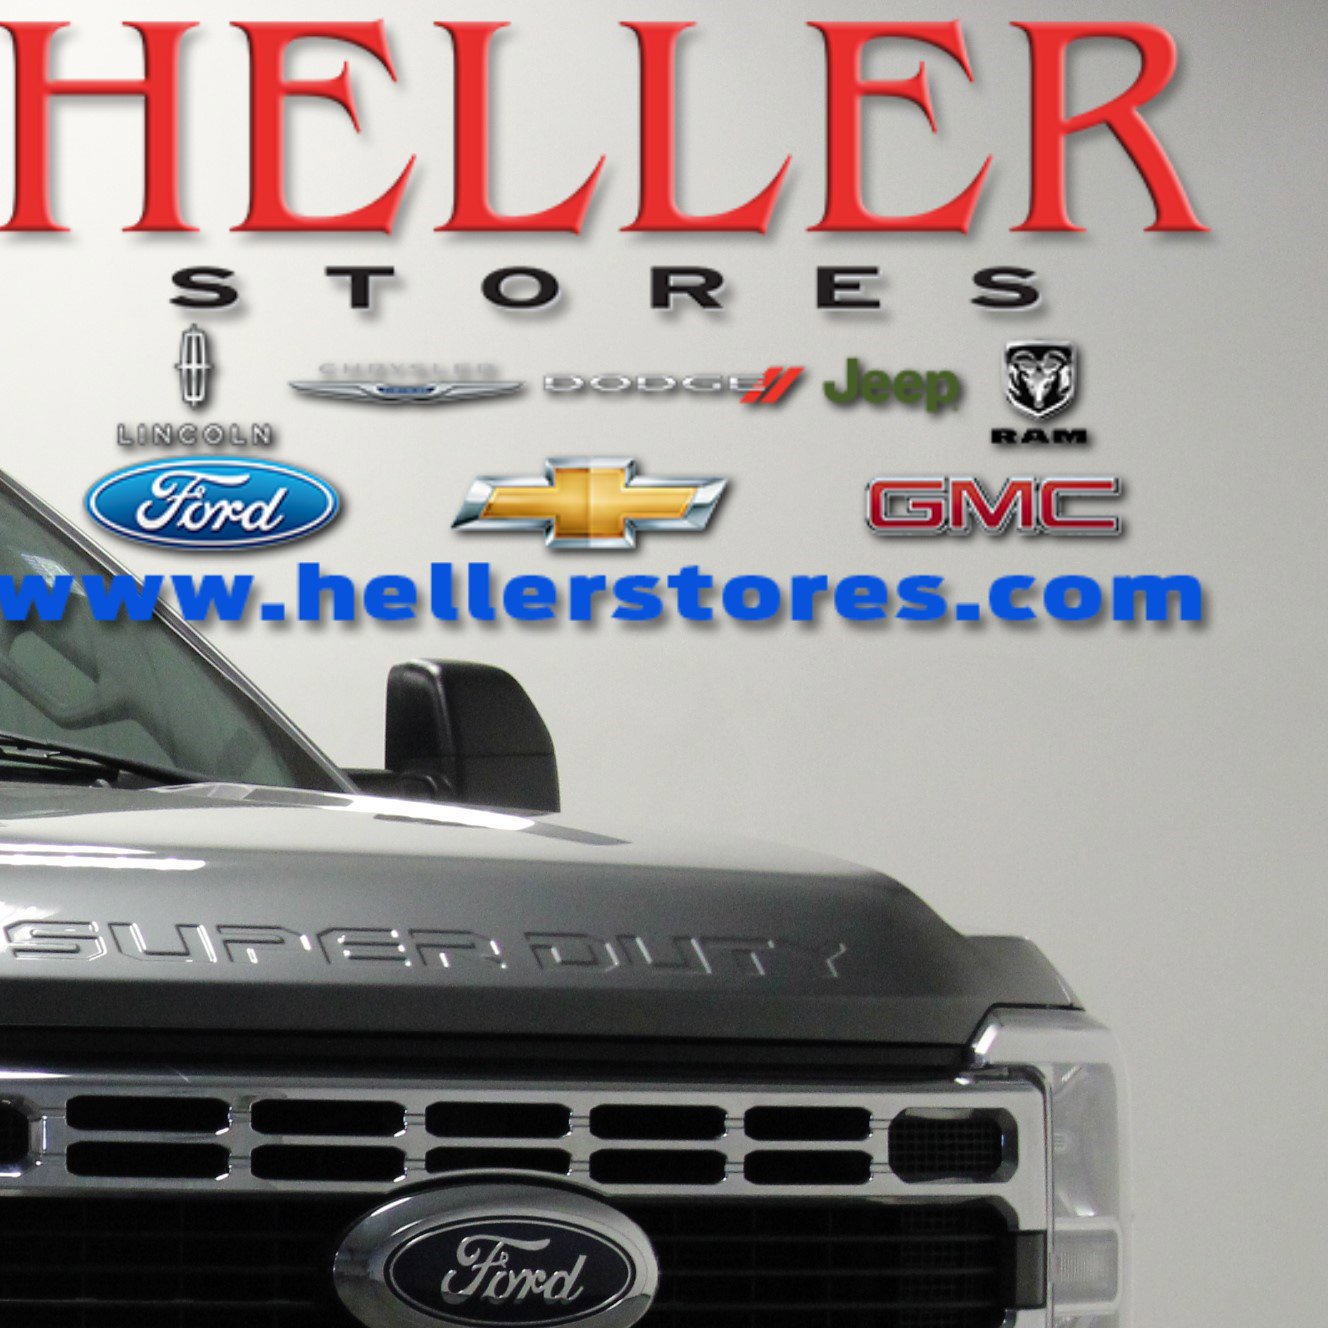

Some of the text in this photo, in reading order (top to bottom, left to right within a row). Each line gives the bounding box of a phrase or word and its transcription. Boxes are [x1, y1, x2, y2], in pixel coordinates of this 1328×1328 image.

[2, 918, 849, 979] SUPER DUTY
[440, 1233, 588, 1305] Ford
